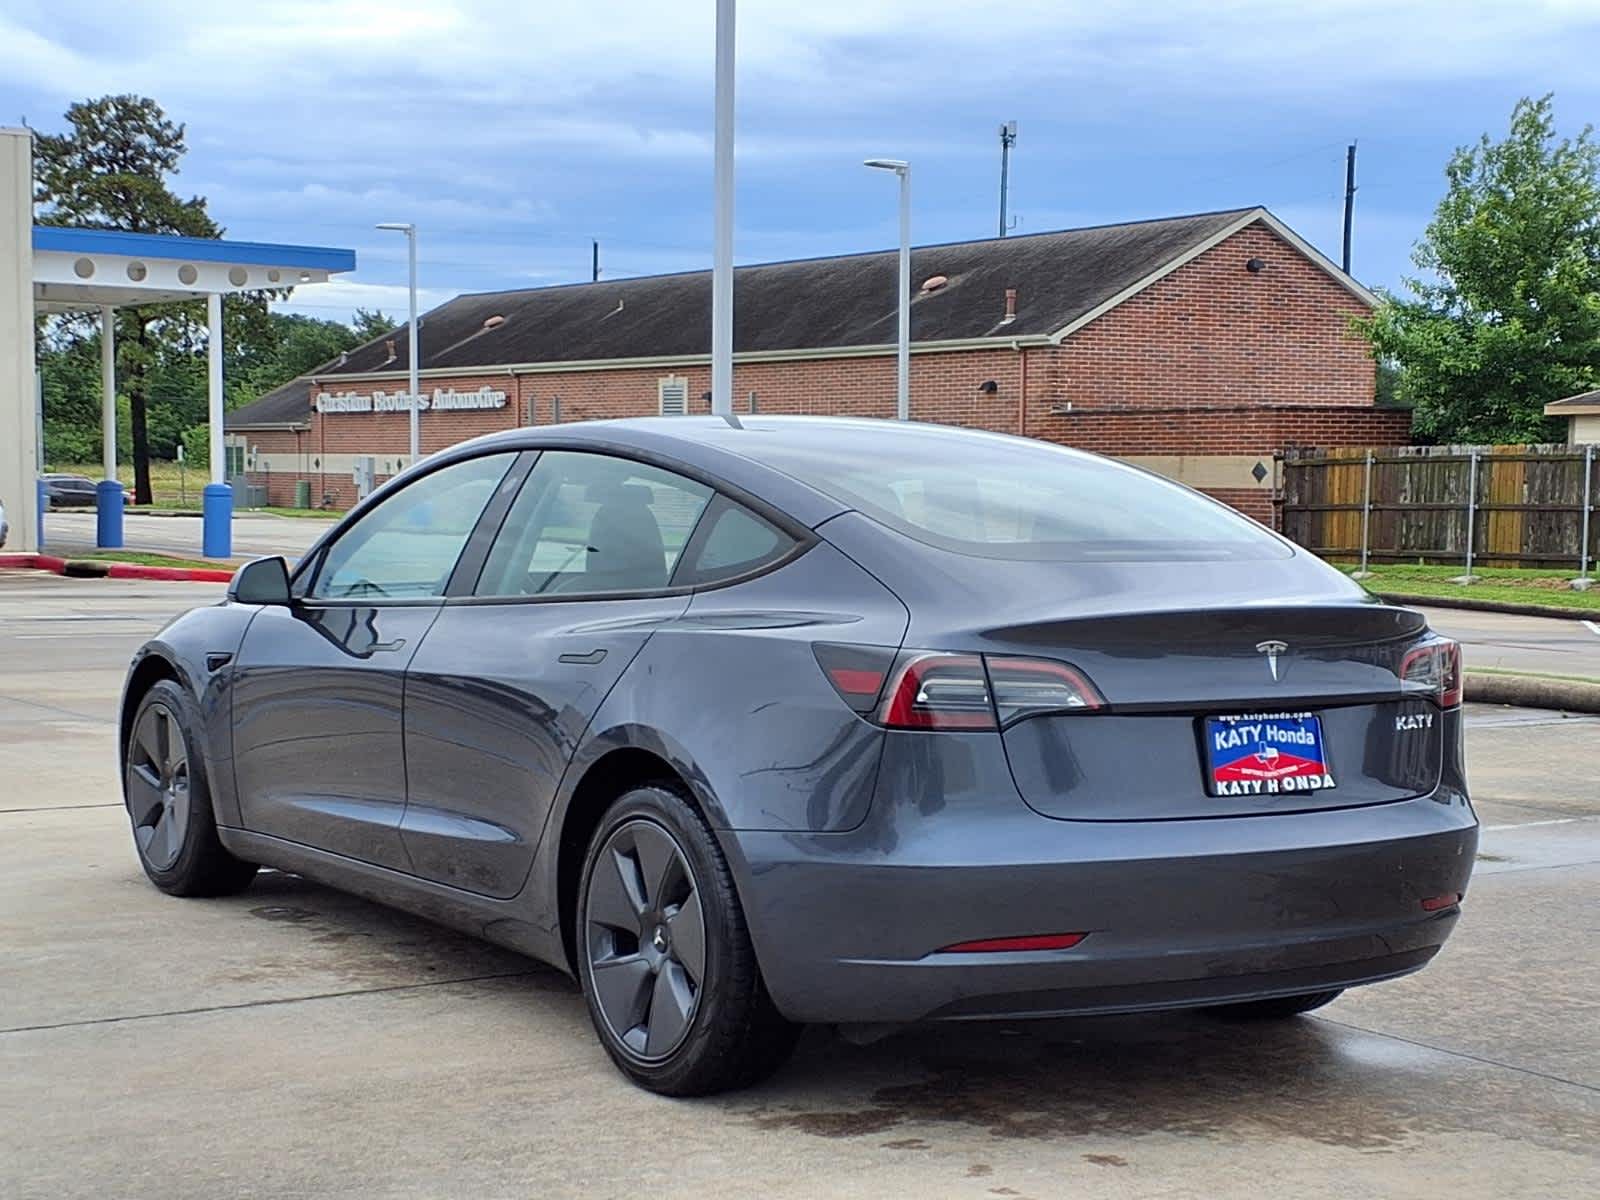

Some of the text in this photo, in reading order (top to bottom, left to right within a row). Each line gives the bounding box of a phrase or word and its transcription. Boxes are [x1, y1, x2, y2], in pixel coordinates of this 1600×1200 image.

[373, 390, 429, 411] Brothes
[431, 385, 506, 409] Automotive
[1396, 713, 1432, 730] KATY
[1215, 724, 1315, 750] KATY Honda
[1216, 774, 1336, 795] KATY HONDA
